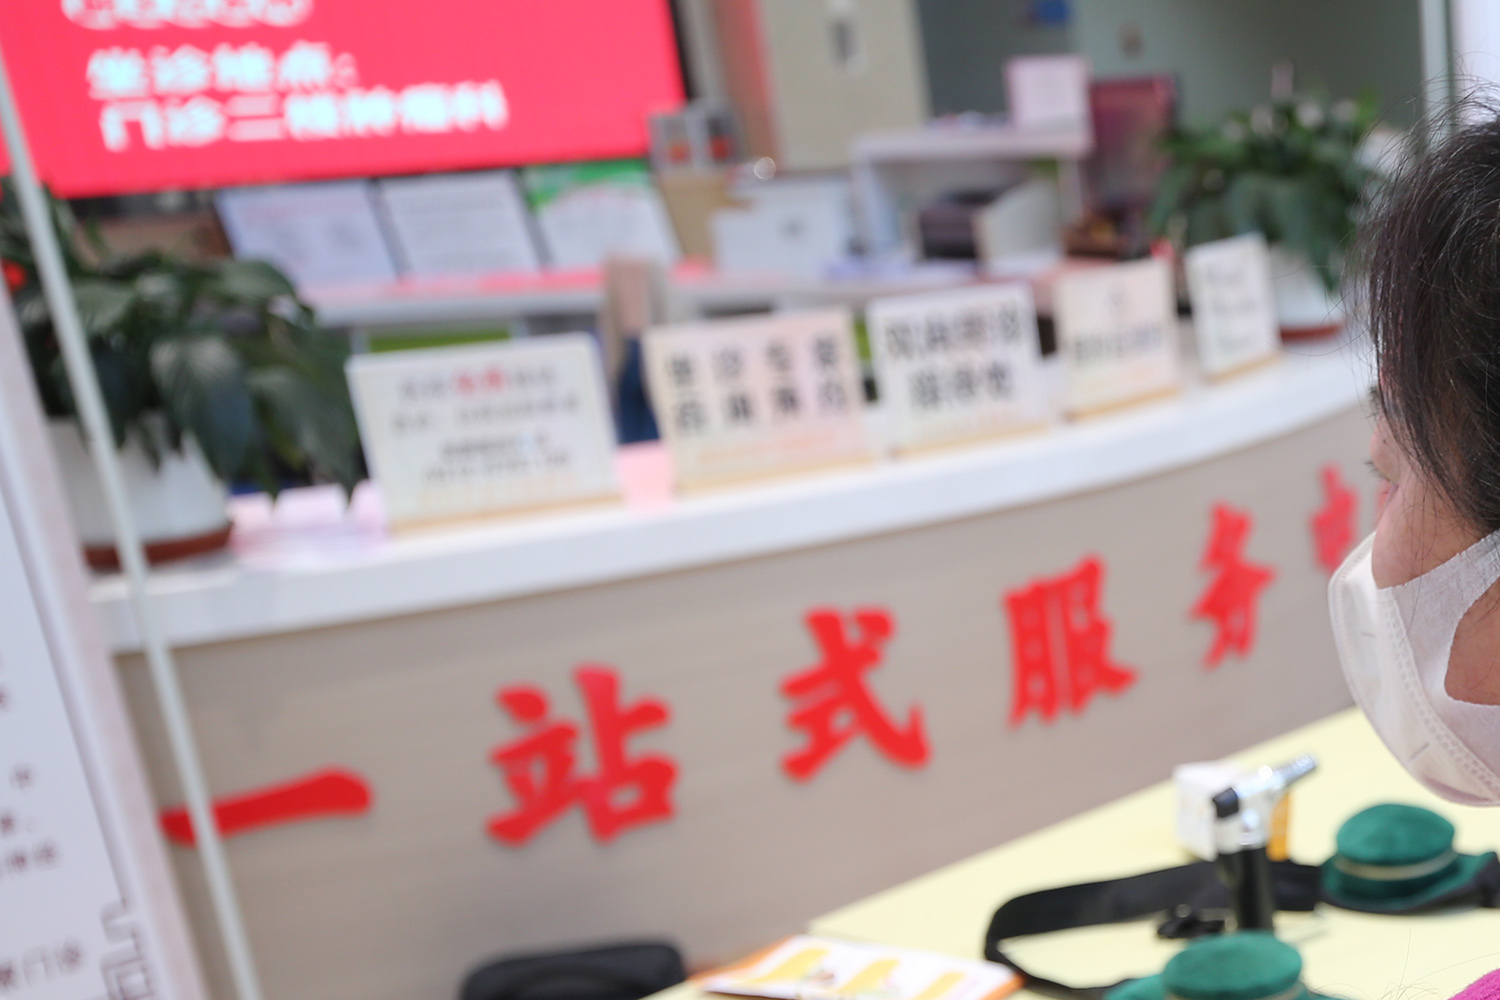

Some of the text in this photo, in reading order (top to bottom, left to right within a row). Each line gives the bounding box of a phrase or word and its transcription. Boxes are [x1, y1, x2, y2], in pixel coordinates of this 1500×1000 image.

[160, 462, 1392, 846] 一站式服务中
